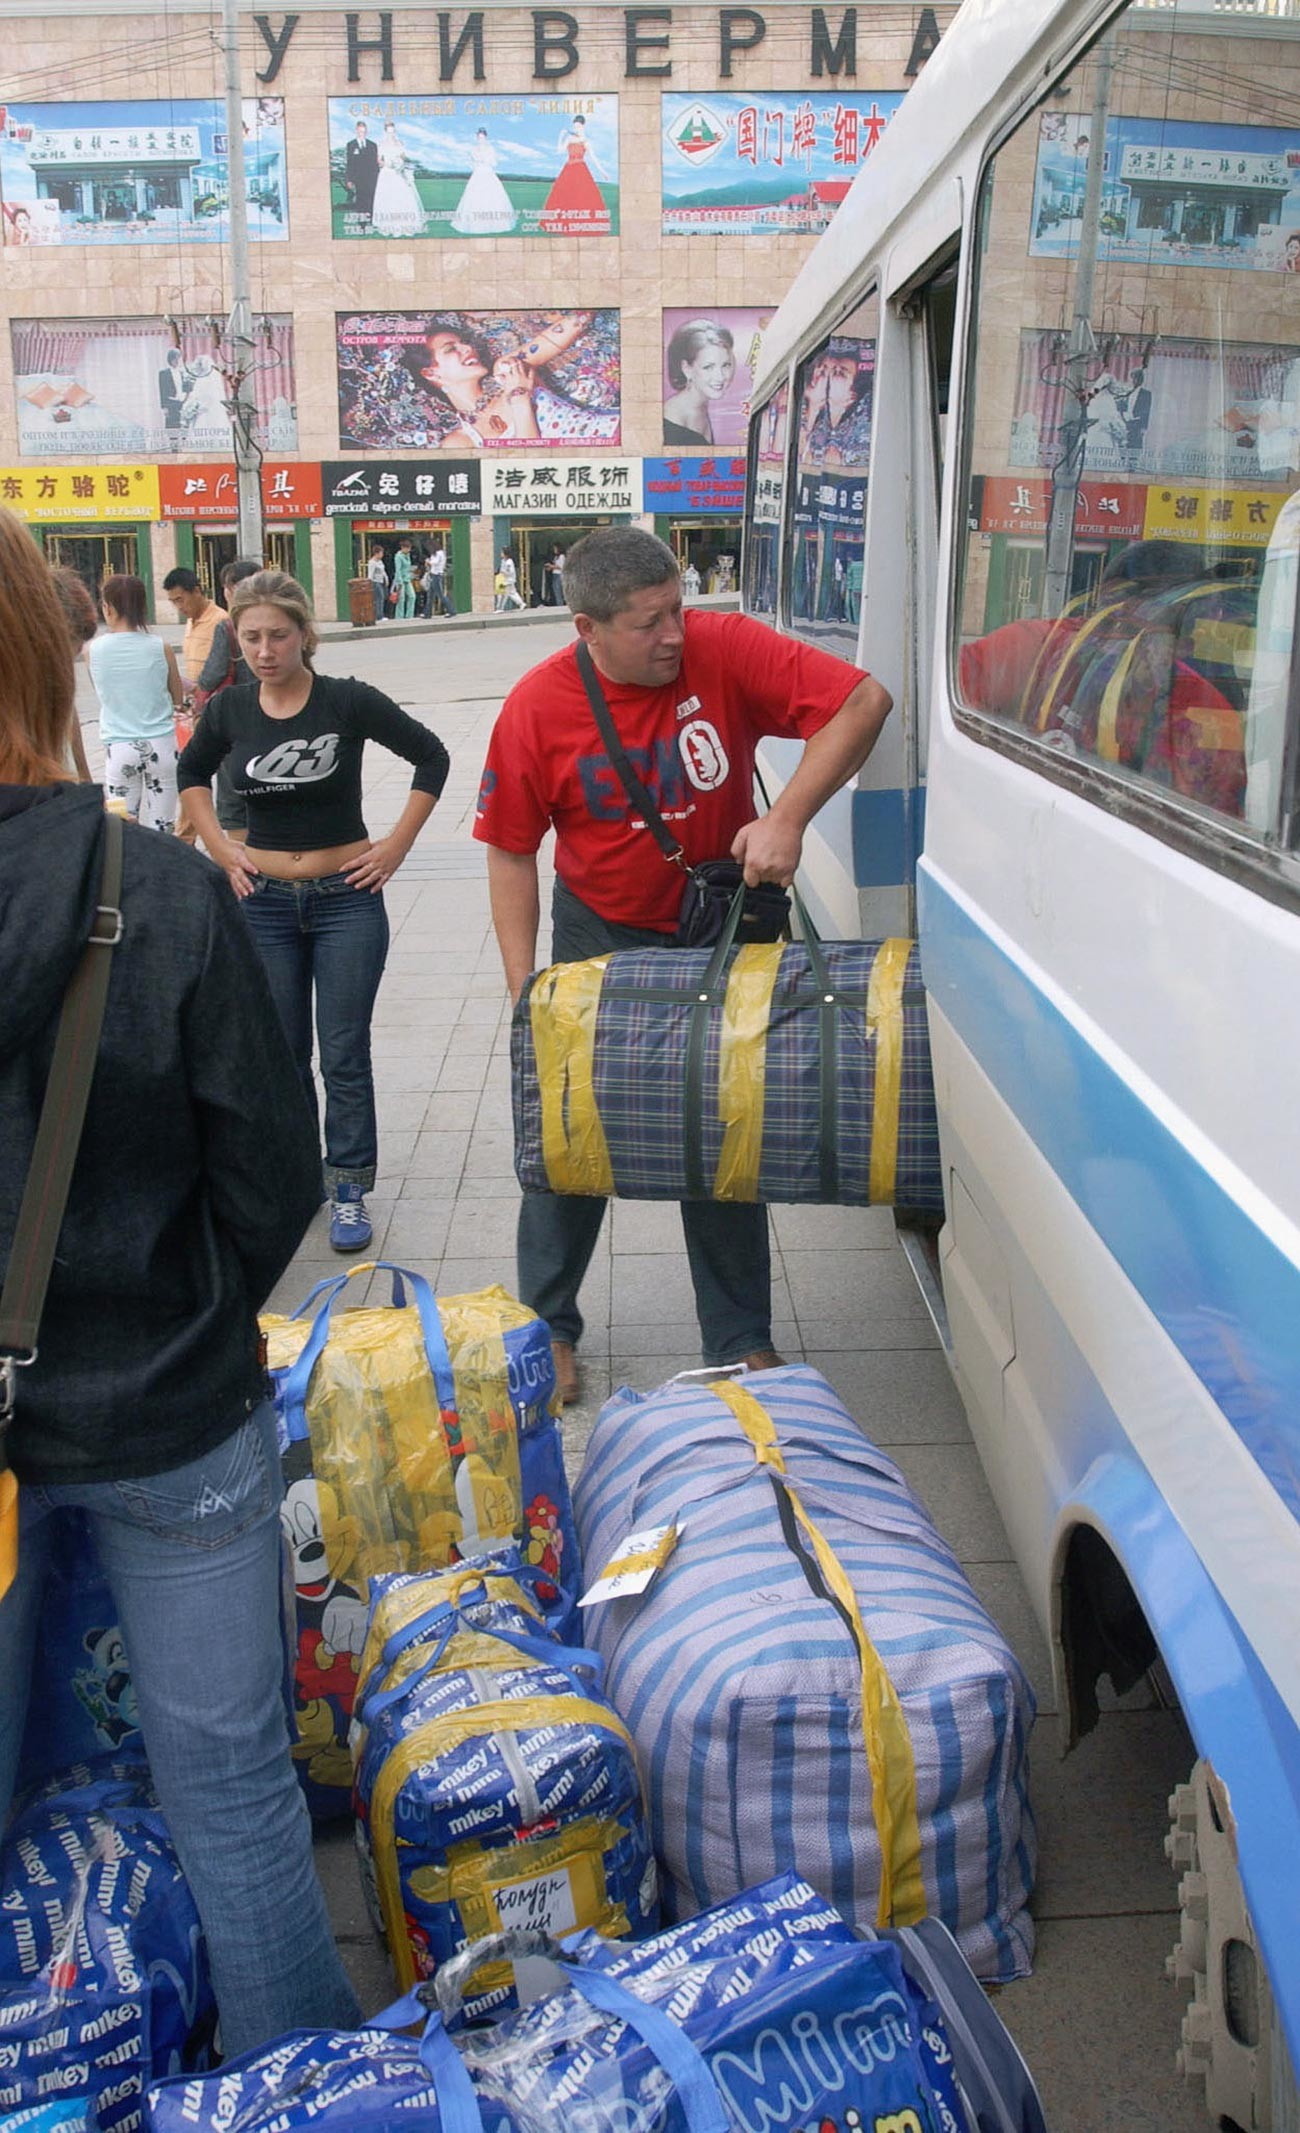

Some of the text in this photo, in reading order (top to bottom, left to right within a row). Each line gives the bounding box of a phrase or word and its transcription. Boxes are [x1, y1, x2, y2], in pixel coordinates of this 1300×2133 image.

[493, 491, 632, 509] МАГАЗИН ОДЕЖДЫ
[437, 1748, 489, 1792] mikey
[448, 1799, 504, 1836] mikey
[80, 2002, 143, 2043] mikey
